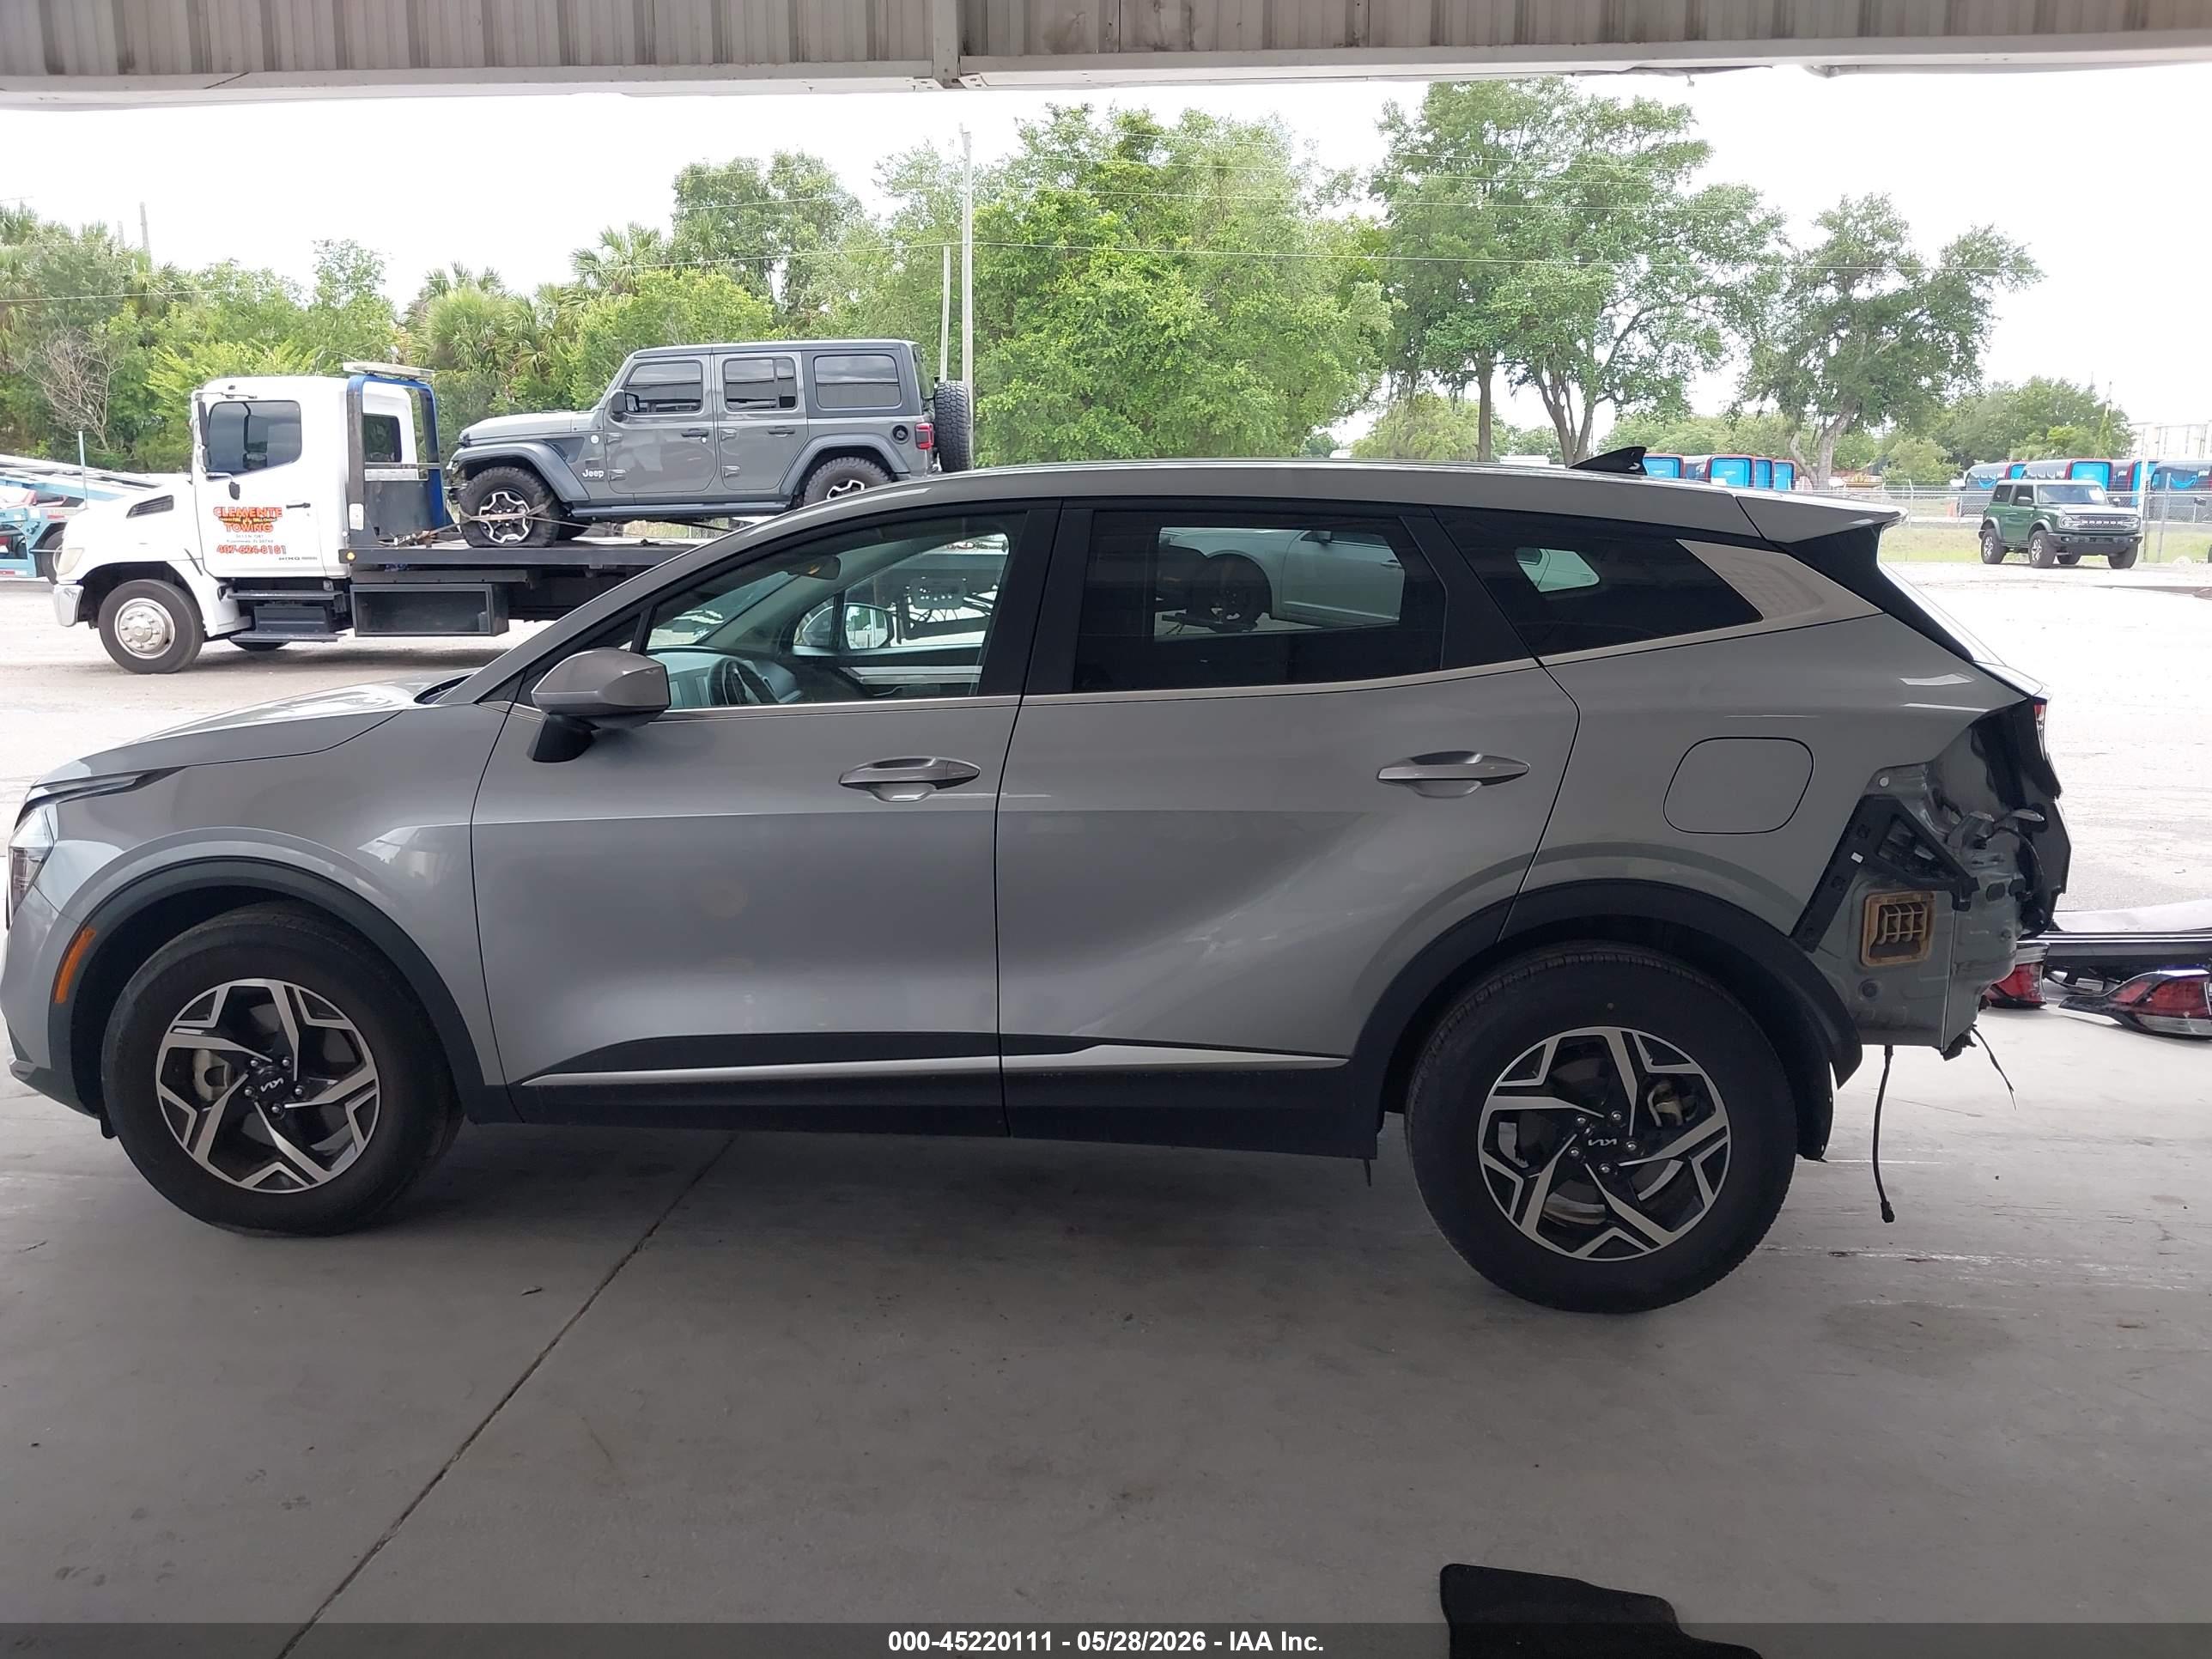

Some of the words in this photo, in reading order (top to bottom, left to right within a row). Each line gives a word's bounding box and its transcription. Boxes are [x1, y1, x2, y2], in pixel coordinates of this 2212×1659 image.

[582, 469, 605, 478] Jeep
[213, 507, 283, 518] CLEMENTE
[224, 522, 273, 532] TOWING
